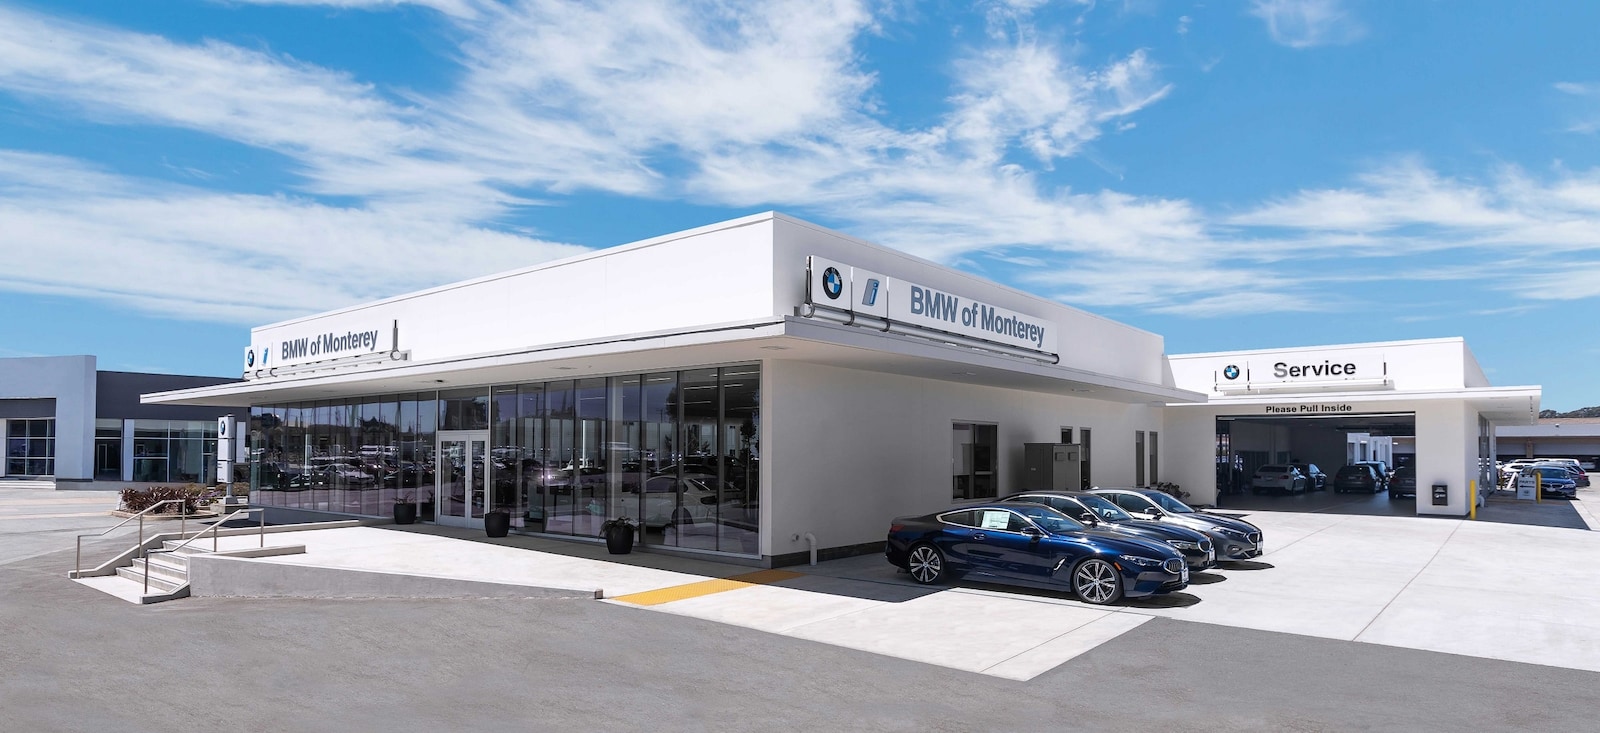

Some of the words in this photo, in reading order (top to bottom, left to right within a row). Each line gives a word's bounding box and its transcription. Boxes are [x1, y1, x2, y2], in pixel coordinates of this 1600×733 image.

[910, 286, 959, 323] BMW
[962, 302, 979, 327] of
[981, 304, 1045, 348] Monterey
[281, 338, 309, 360] BMW
[311, 335, 321, 355] of
[323, 330, 378, 354] Monterey
[1273, 360, 1356, 378] Service
[1266, 405, 1297, 413] Please
[1300, 404, 1318, 412] Pull
[1321, 403, 1352, 412] Inside
